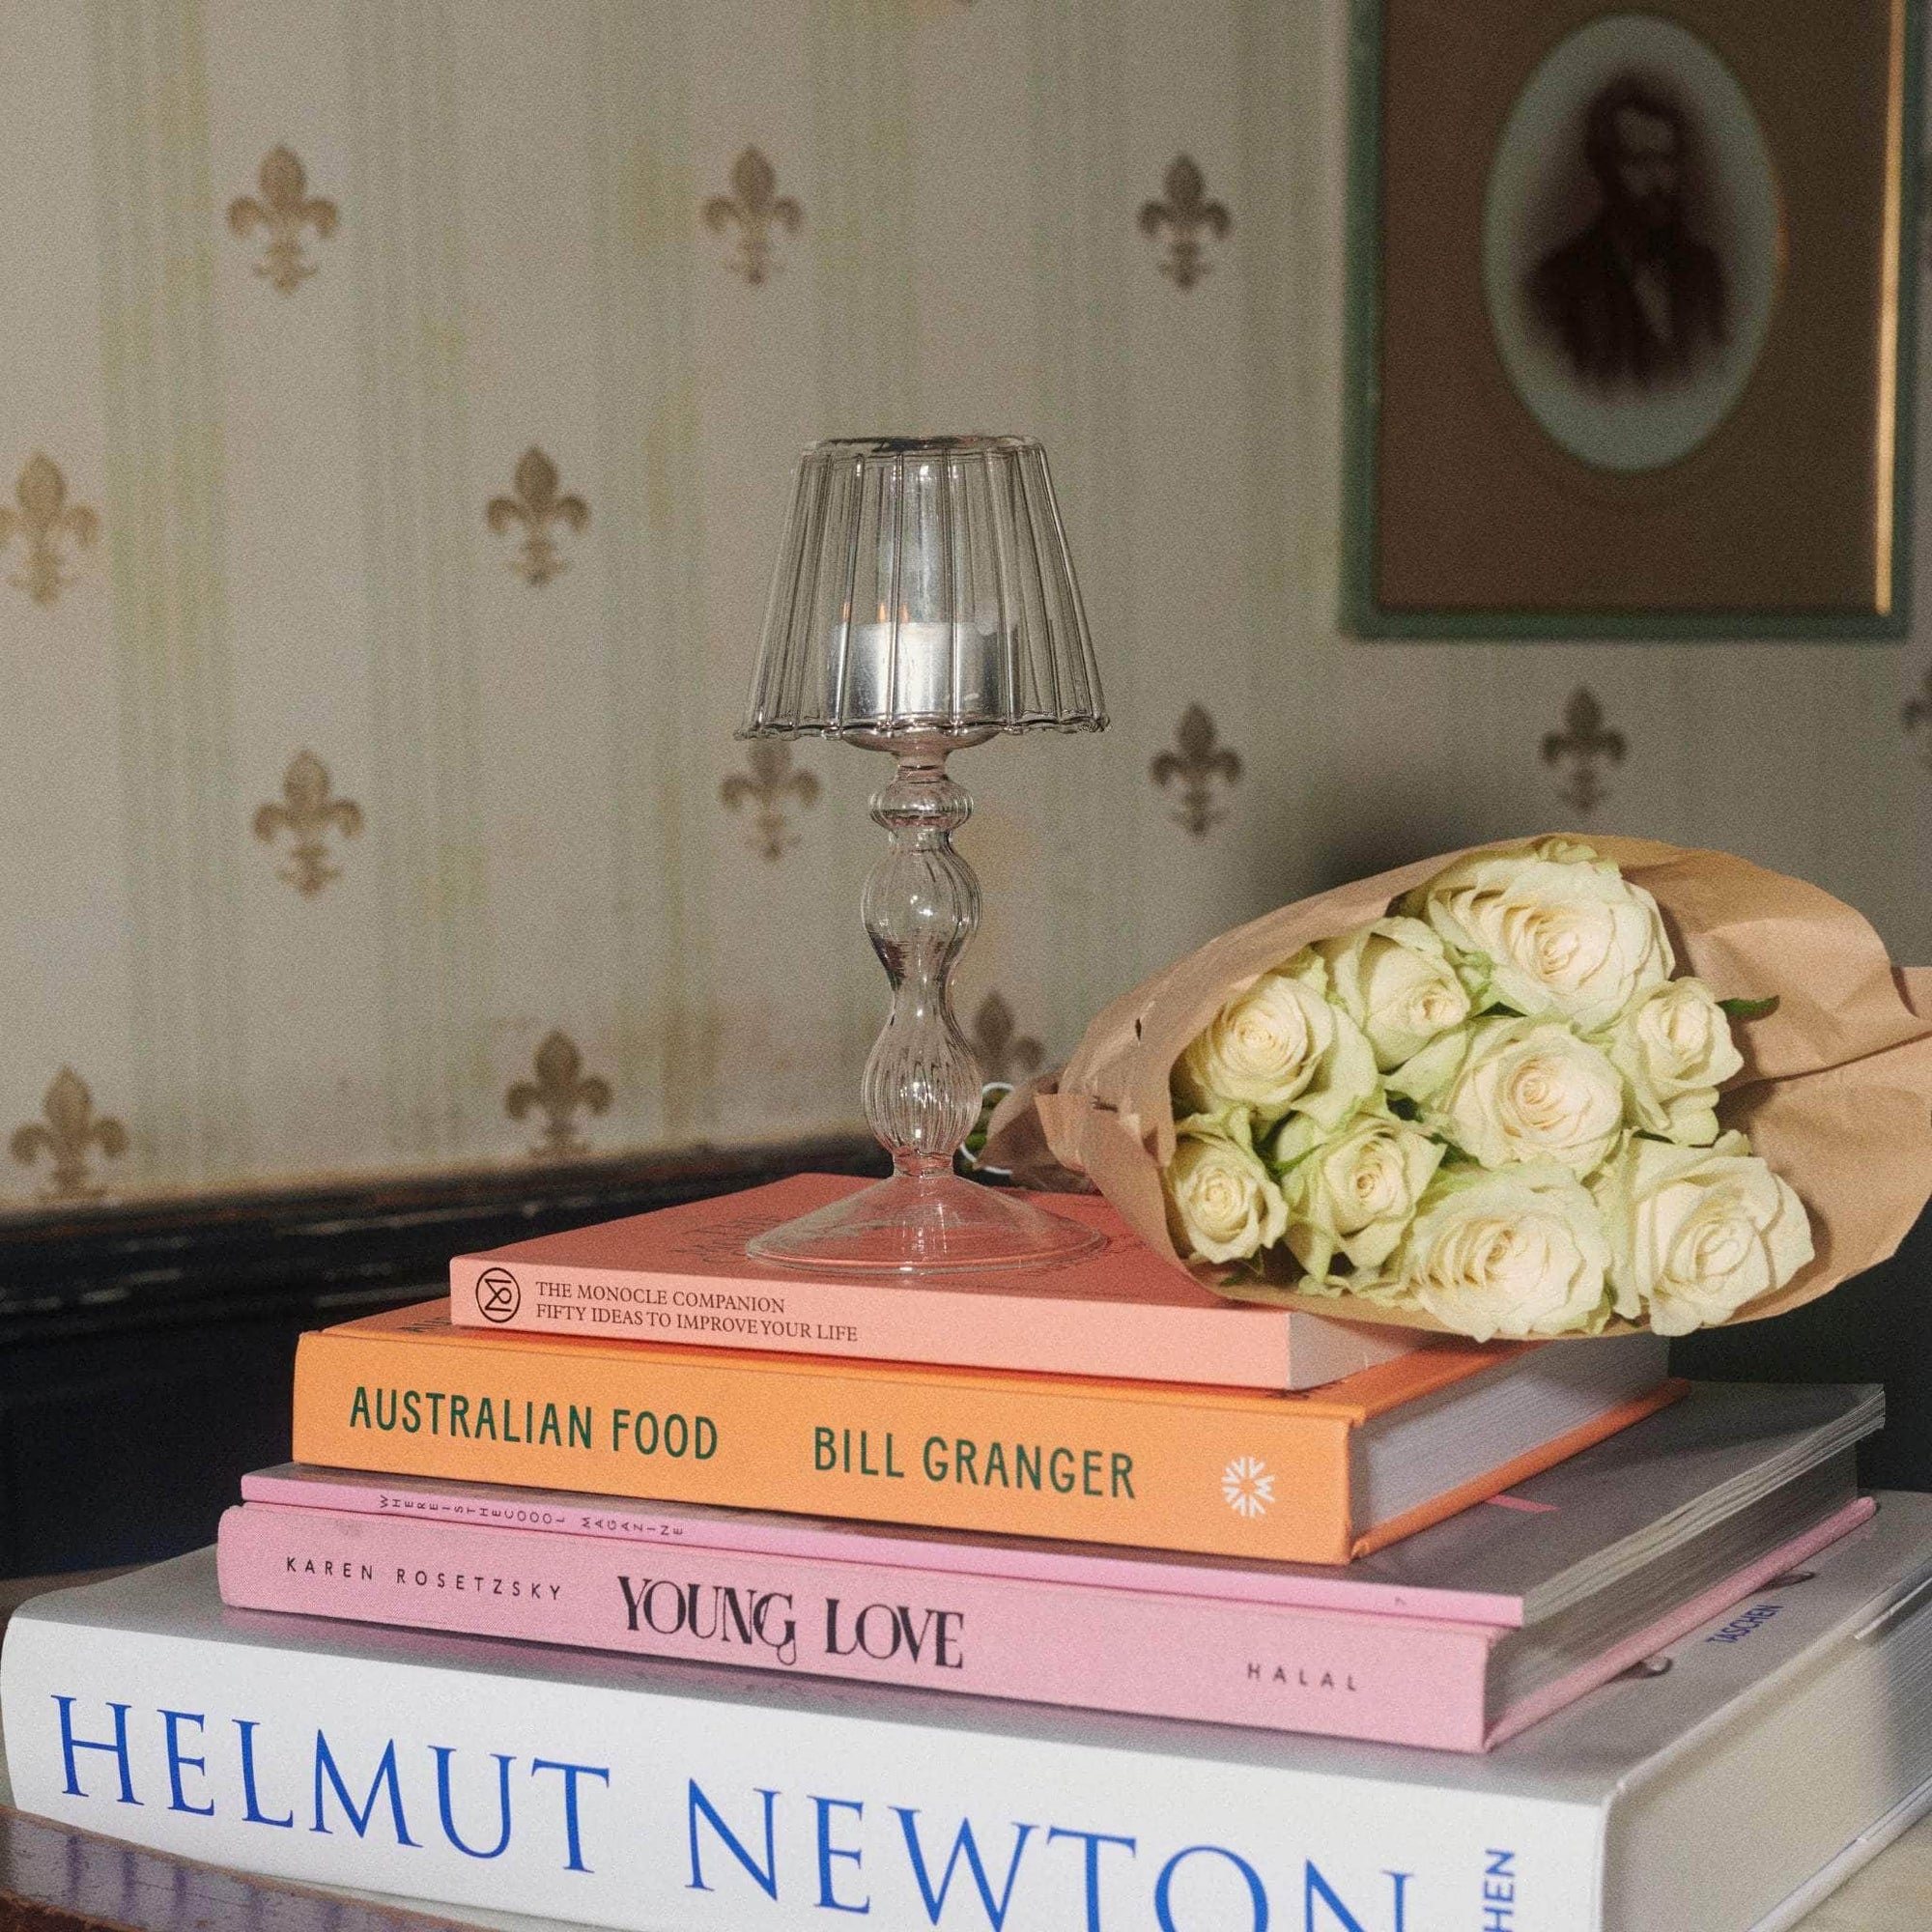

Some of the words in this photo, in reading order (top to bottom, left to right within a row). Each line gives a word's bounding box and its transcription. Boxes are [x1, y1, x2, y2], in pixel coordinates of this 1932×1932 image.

[535, 1281, 572, 1299] THE
[578, 1285, 669, 1306] MONOCLE
[673, 1292, 785, 1314] COMPANION
[536, 1304, 584, 1321] FIFTY
[591, 1308, 642, 1326] IDEAS
[645, 1312, 671, 1327] TO
[677, 1315, 758, 1335] IMPROVE
[759, 1321, 812, 1339] YOUR
[816, 1326, 858, 1342] LIFE
[350, 1386, 592, 1449] AUSTRALIAN
[612, 1408, 718, 1461] FOOD
[815, 1426, 904, 1478] BILL
[923, 1436, 1135, 1499] GRANGER
[380, 1494, 565, 1523] WHEREISTHECOOOL
[582, 1517, 684, 1537] MAGAZINE
[287, 1556, 373, 1580] KAREN
[397, 1569, 560, 1600] ROSETZSKY
[618, 1576, 796, 1665] YOUNG
[825, 1598, 963, 1669] LOVE
[1706, 1604, 1784, 1642] TASCHEN
[1248, 1662, 1357, 1691] HALAL
[50, 1694, 611, 1874] HELMUT
[685, 1777, 1414, 1932] NEWTON
